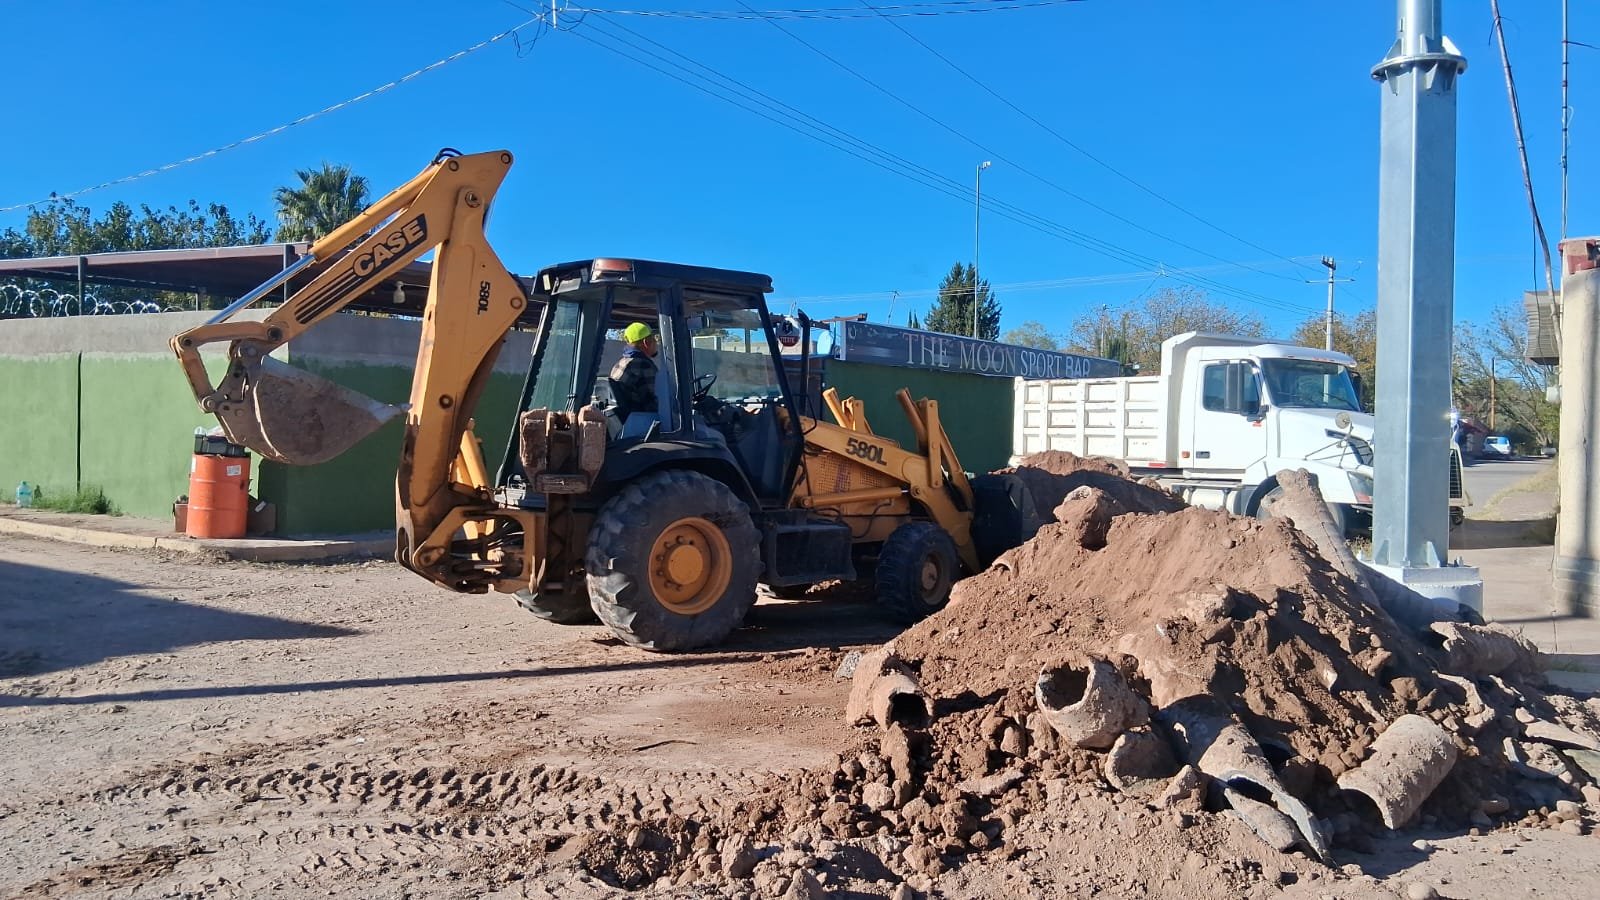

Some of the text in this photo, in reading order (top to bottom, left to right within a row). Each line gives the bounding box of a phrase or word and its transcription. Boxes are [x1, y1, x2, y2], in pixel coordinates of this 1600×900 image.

[353, 219, 424, 276] CASE
[477, 280, 490, 315] 580L
[903, 333, 949, 367] THE
[960, 341, 1016, 373] MOON
[1021, 350, 1062, 378] SPORT
[845, 437, 887, 466] 580L
